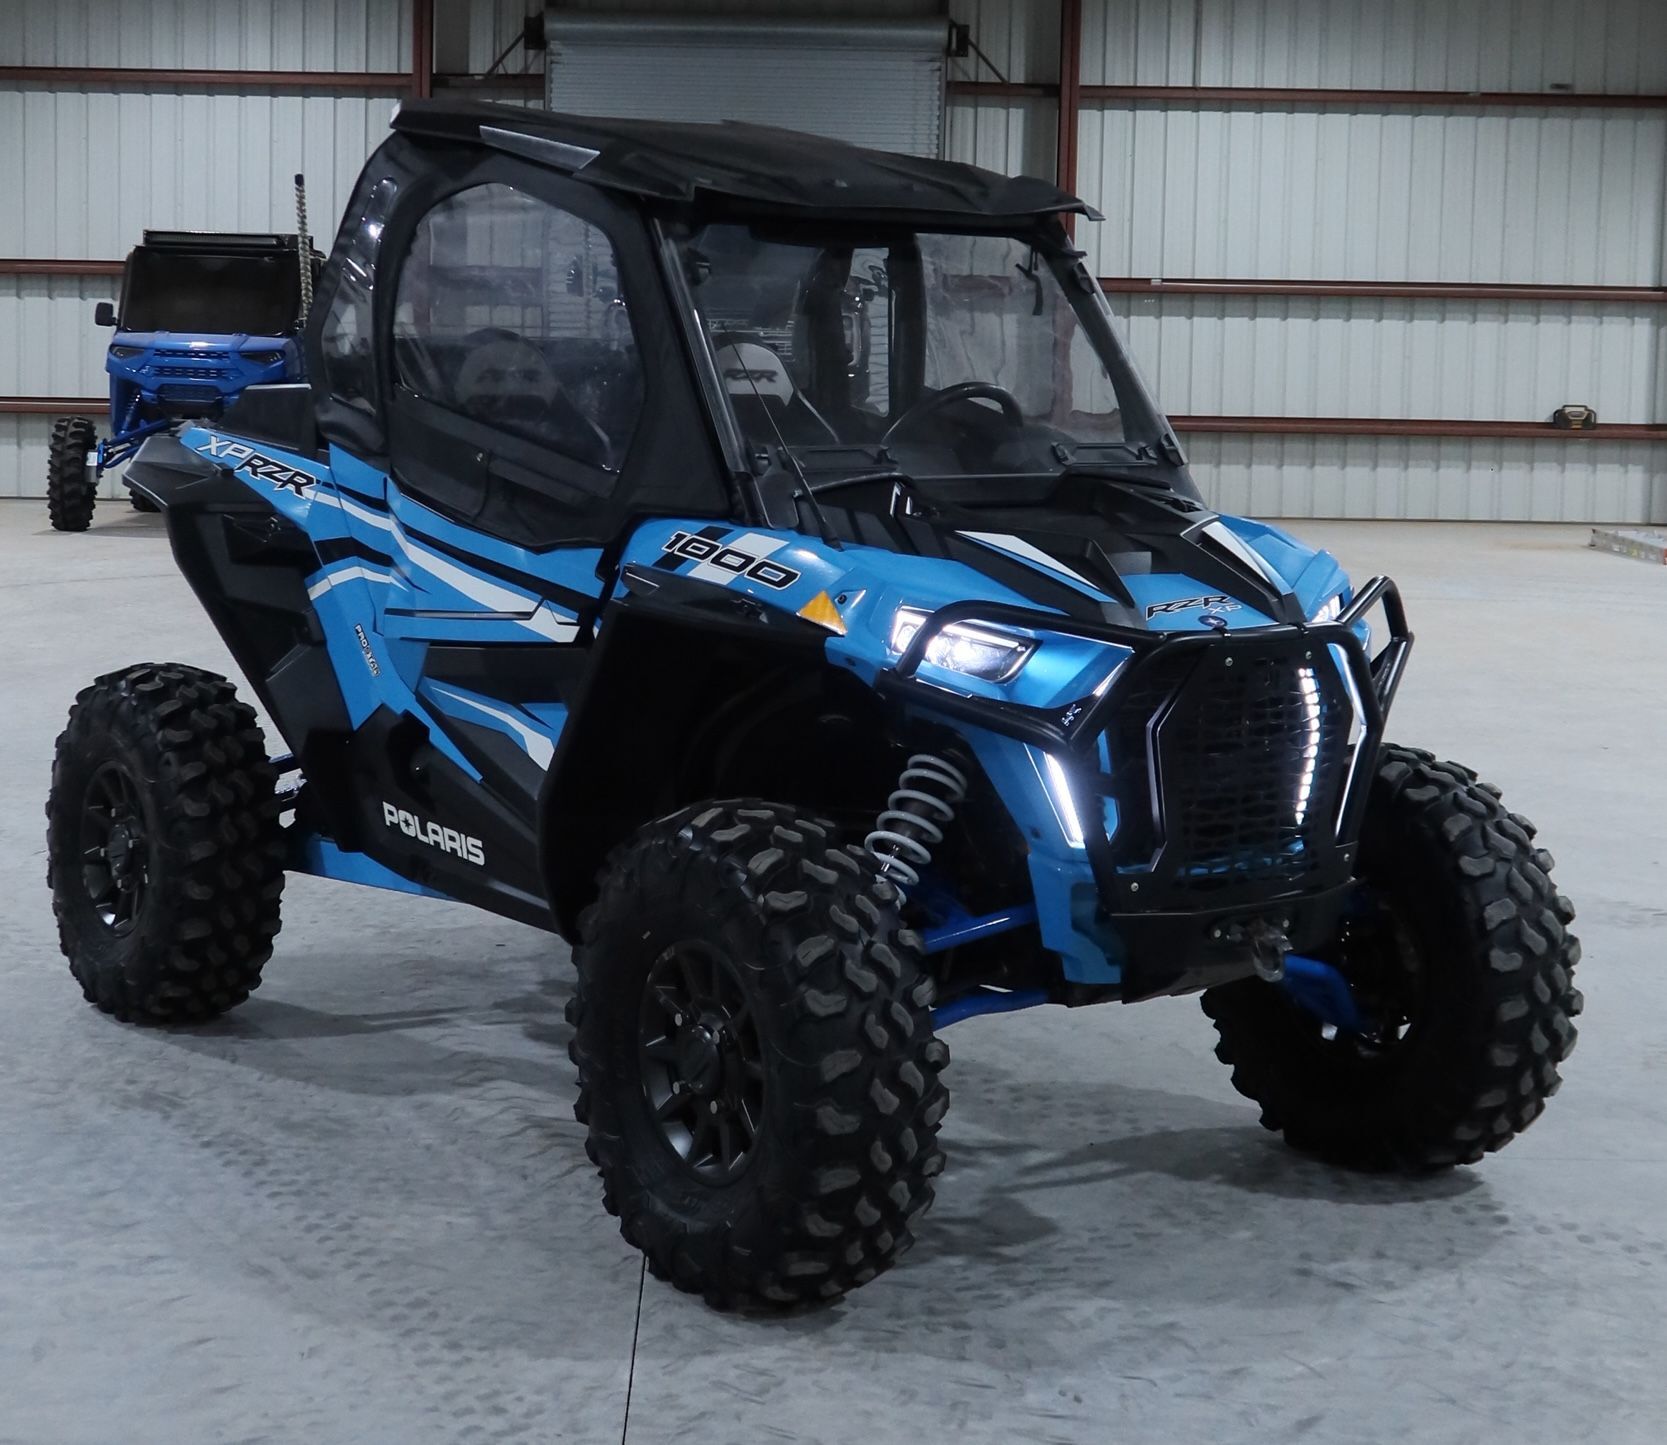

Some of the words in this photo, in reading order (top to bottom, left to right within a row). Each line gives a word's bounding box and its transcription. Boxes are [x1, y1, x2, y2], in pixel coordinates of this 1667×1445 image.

[196, 435, 255, 459] XP
[234, 453, 316, 499] RZR
[661, 531, 801, 591] 1000
[1145, 595, 1230, 621] RZR
[382, 801, 485, 866] POLARIS
